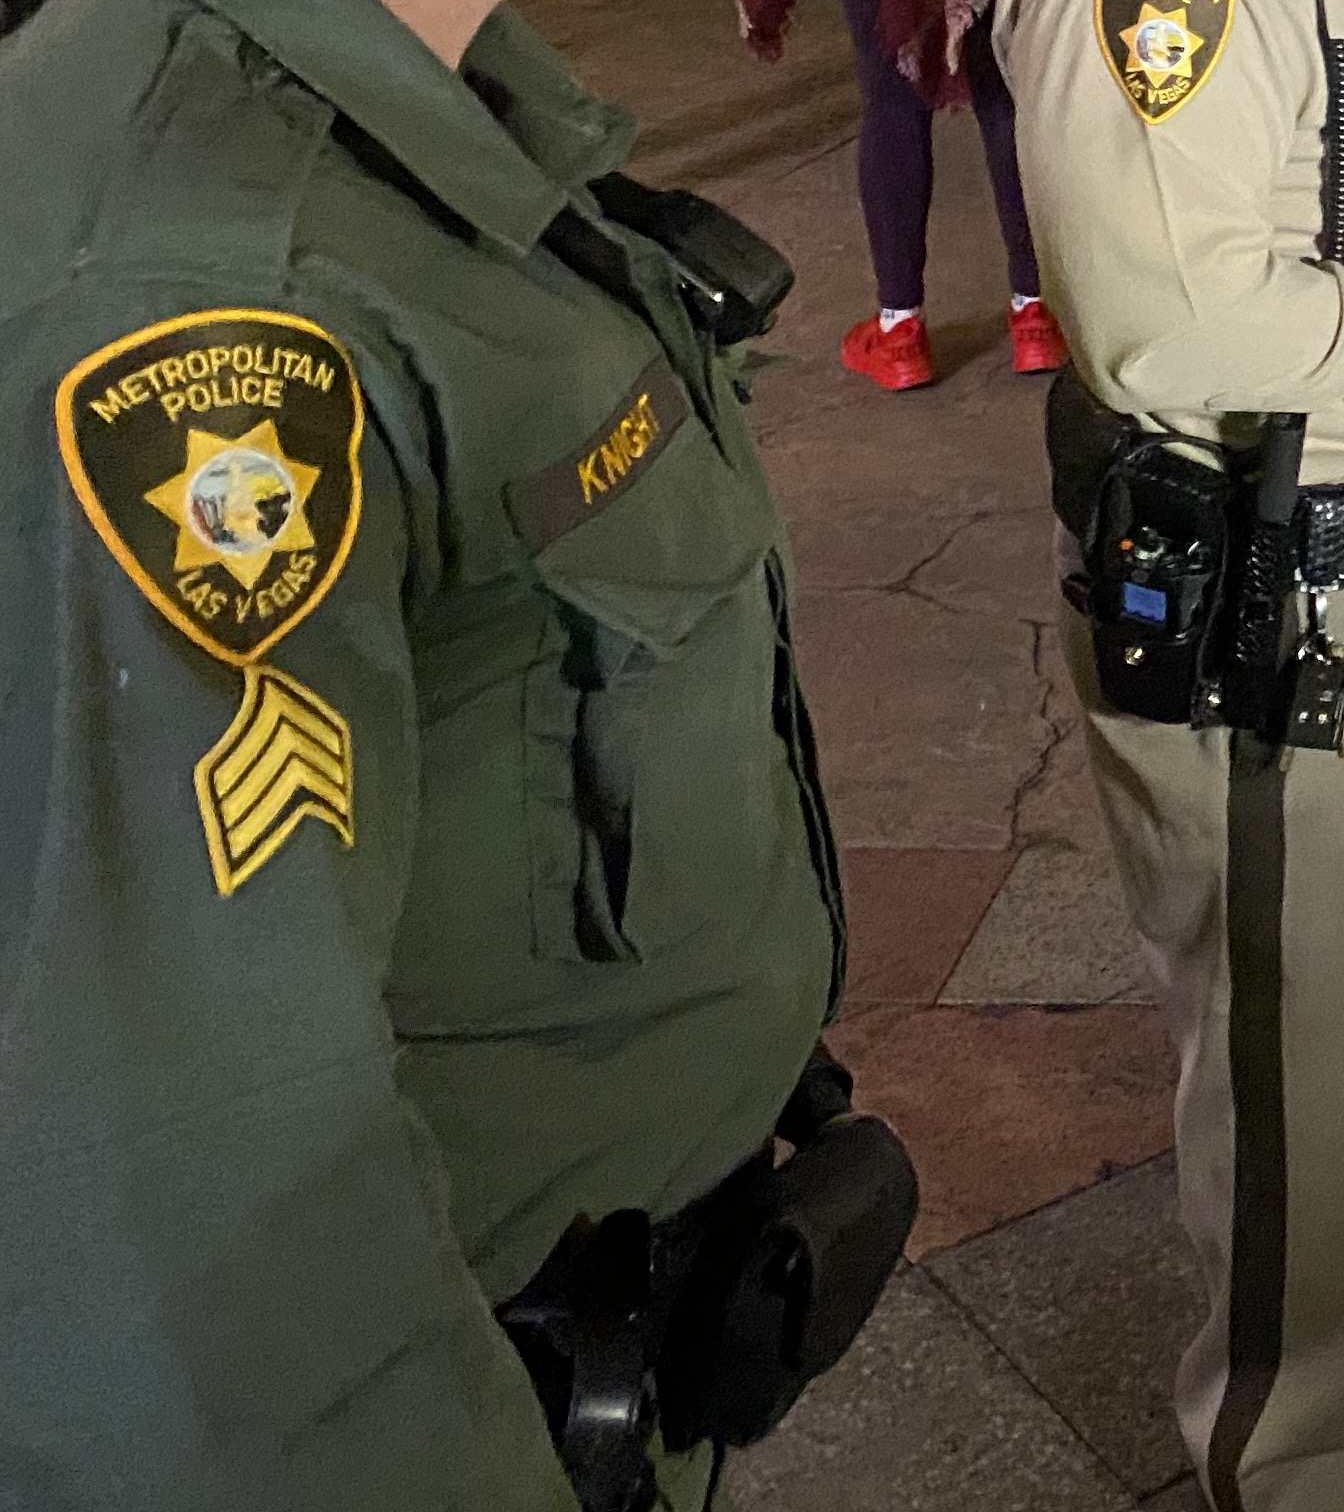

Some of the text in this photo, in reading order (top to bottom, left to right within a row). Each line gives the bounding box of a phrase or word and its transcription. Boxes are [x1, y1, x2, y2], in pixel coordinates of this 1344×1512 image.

[1147, 76, 1192, 105] VEGAS
[89, 344, 334, 424] METROPOLITAN
[160, 376, 284, 423] POLICE
[176, 552, 318, 623] LAS VEGAS
